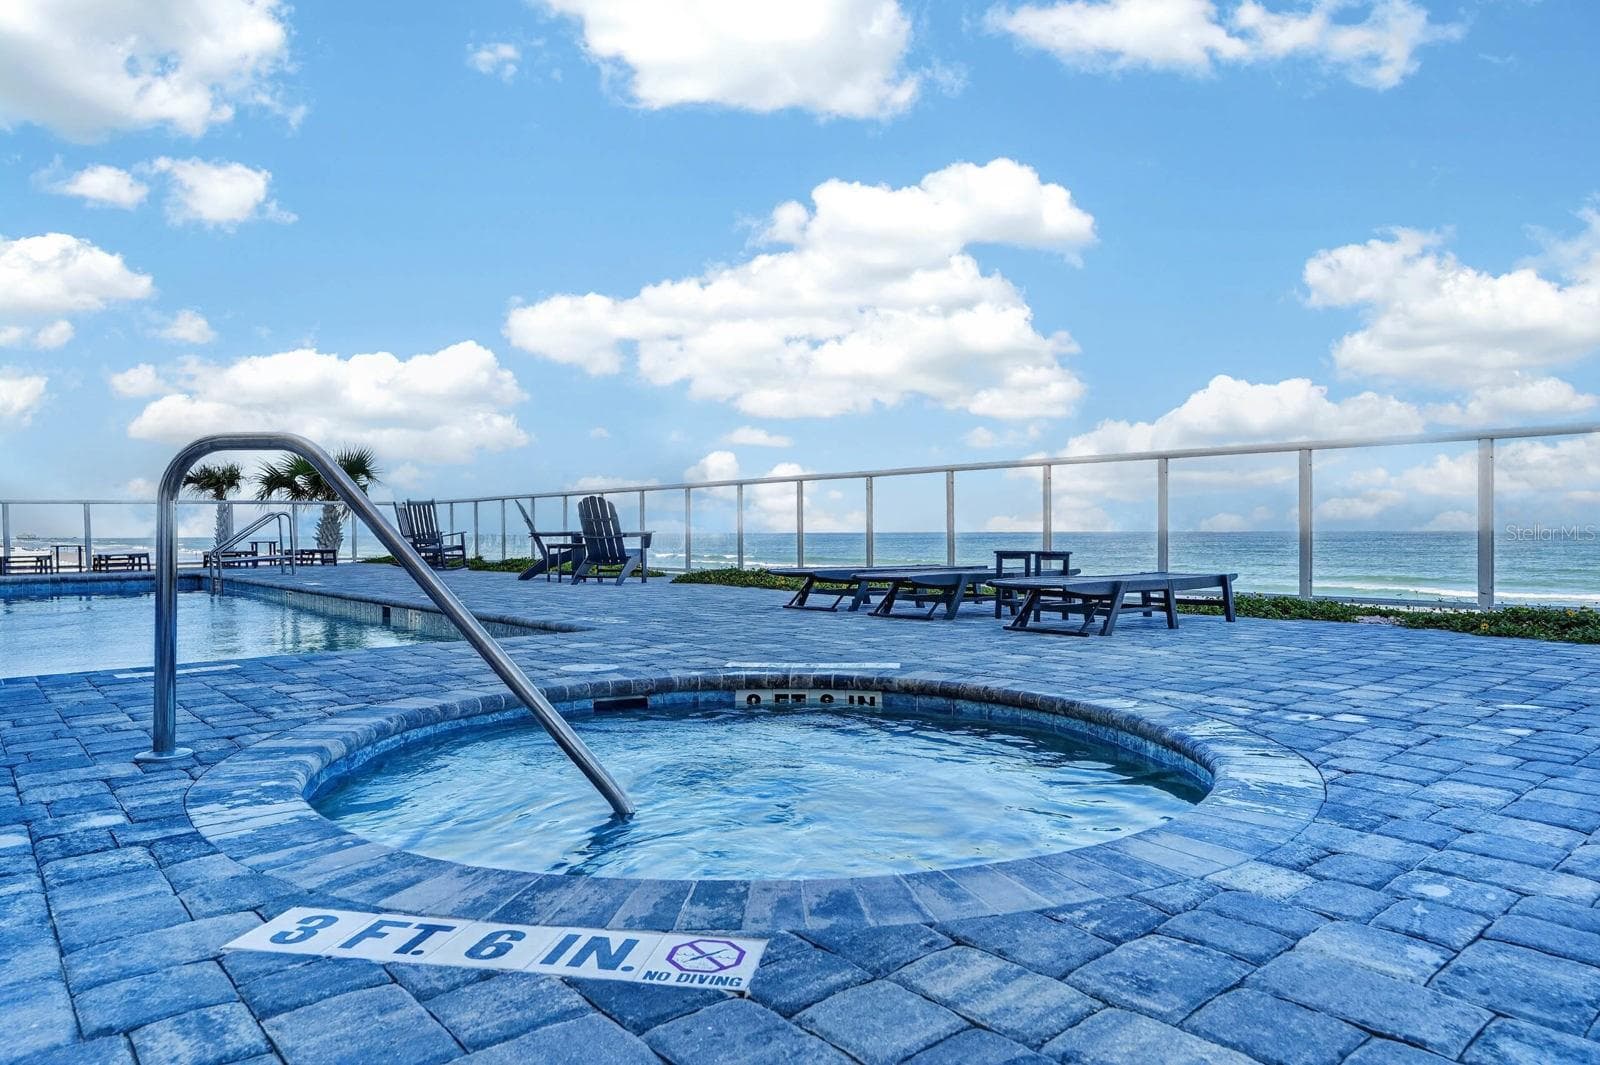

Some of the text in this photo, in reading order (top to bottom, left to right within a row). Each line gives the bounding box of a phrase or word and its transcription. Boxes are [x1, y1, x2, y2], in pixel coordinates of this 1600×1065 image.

[269, 914, 640, 972] 3 FT. 6 IN.
[642, 970, 744, 987] NO DIVING
